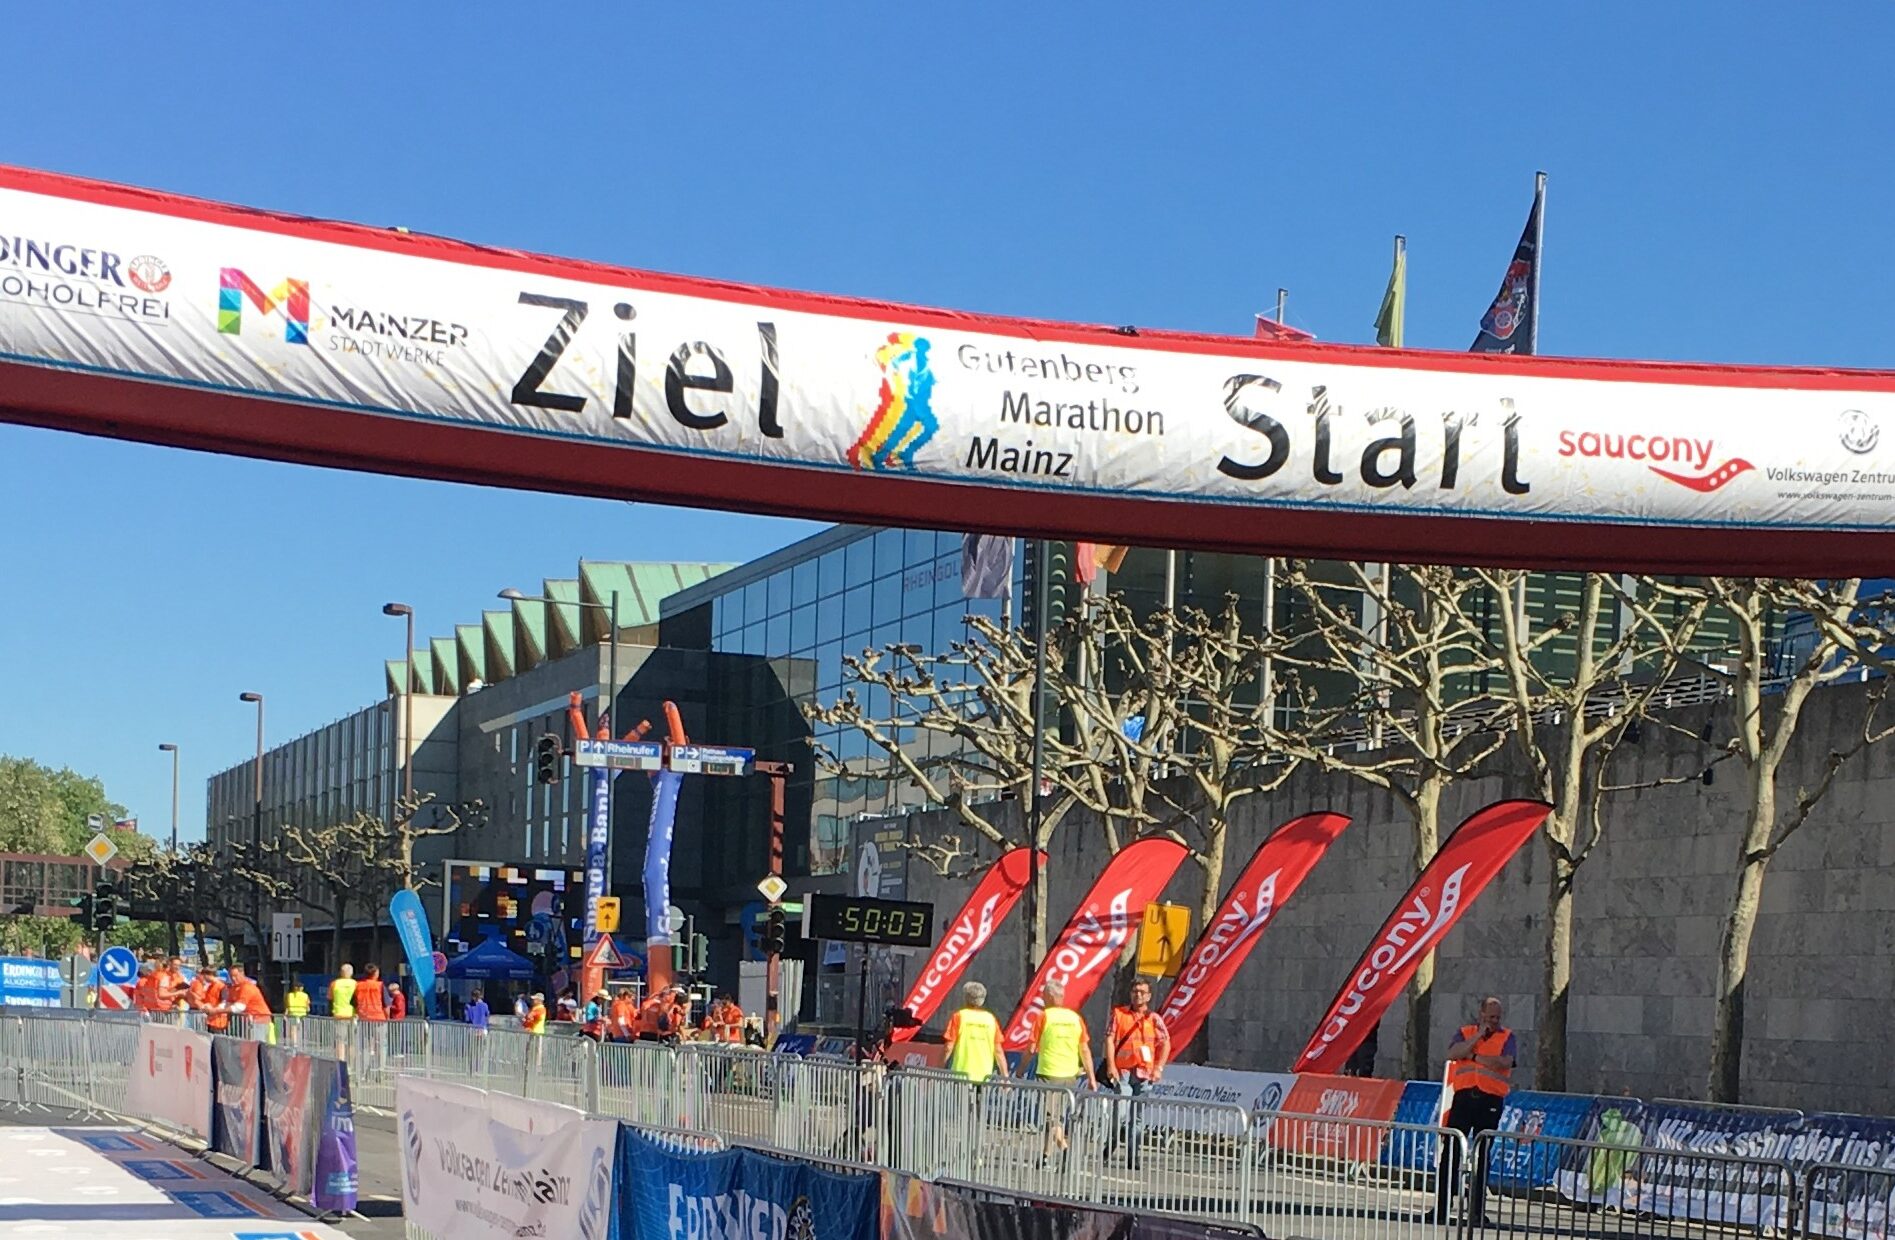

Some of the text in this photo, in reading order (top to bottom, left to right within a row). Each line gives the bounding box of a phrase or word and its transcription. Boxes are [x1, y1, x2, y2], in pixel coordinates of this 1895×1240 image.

[511, 291, 784, 439] Ziel
[957, 344, 1139, 394] Gutenberg
[1000, 389, 1165, 436] Marathon
[1217, 373, 1531, 496] Start
[965, 436, 1074, 478] Mainz
[1558, 429, 1715, 470] saucony
[1766, 467, 1849, 486] Volkswagen
